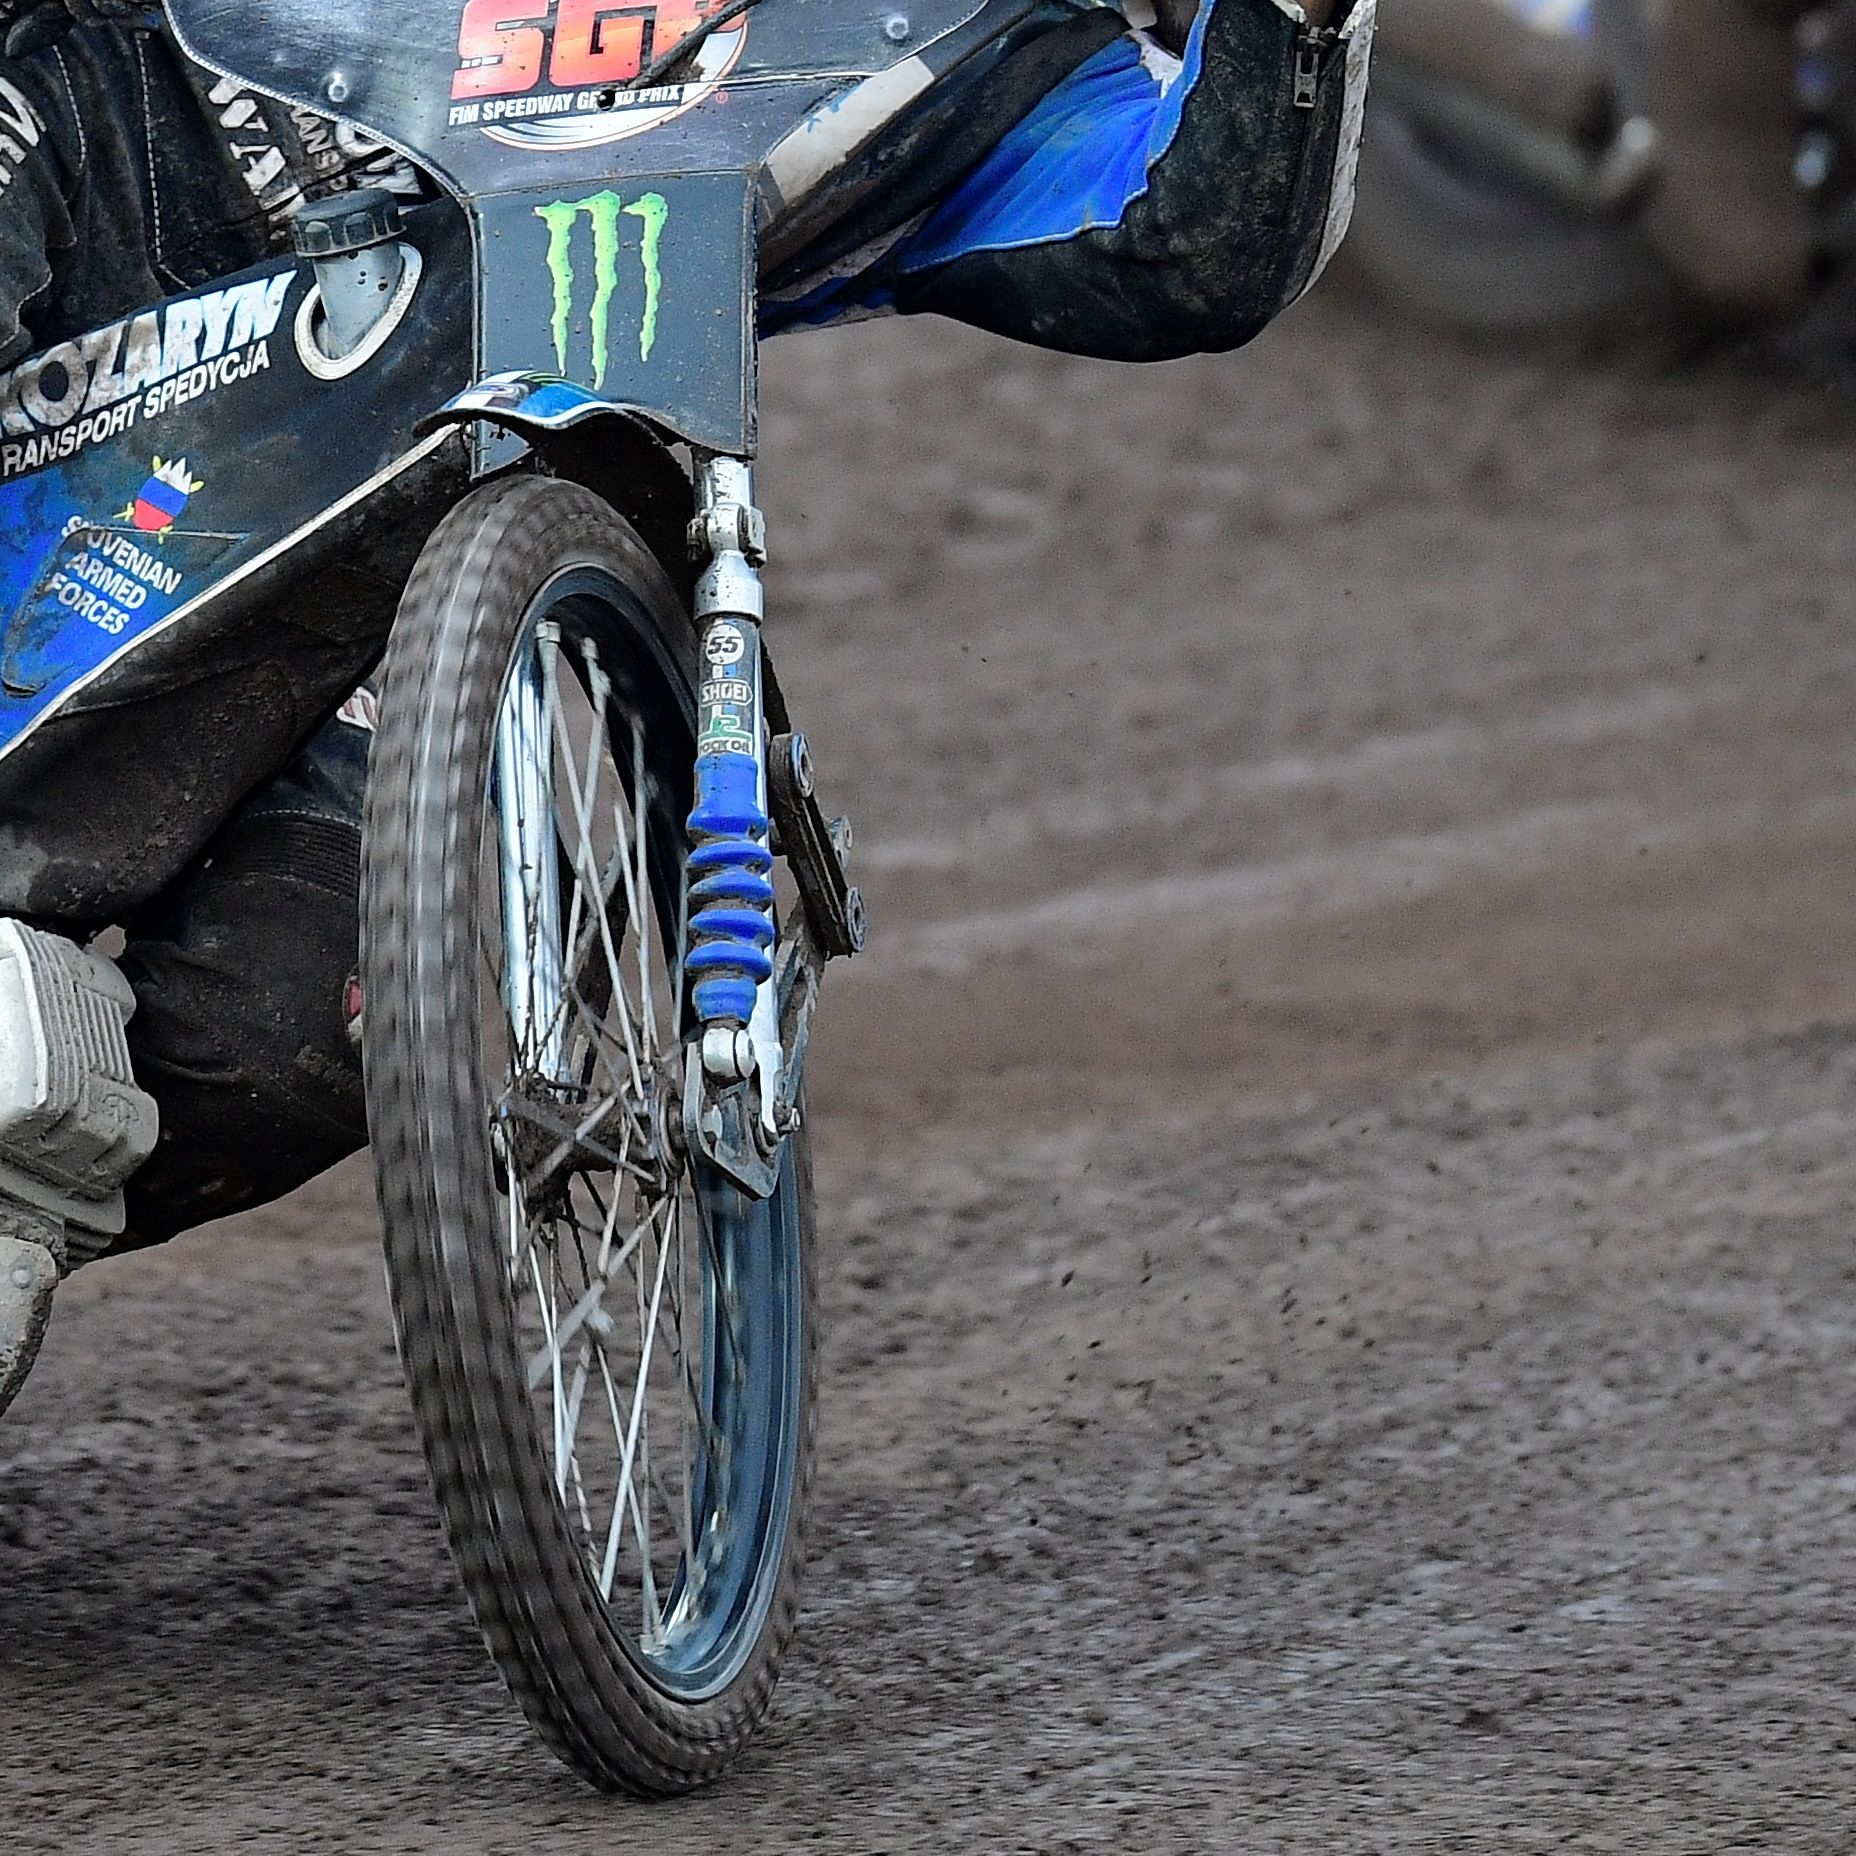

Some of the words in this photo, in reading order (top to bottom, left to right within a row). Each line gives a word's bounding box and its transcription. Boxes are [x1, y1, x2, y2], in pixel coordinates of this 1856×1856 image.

[449, 104, 478, 127] FIM
[483, 93, 574, 122] SPEEDWAY
[143, 340, 270, 420] SPEDYCJA
[44, 572, 130, 634] FORCES
[65, 551, 147, 610] ARMED
[707, 635, 742, 655] 55
[701, 683, 747, 703] SHOEI
